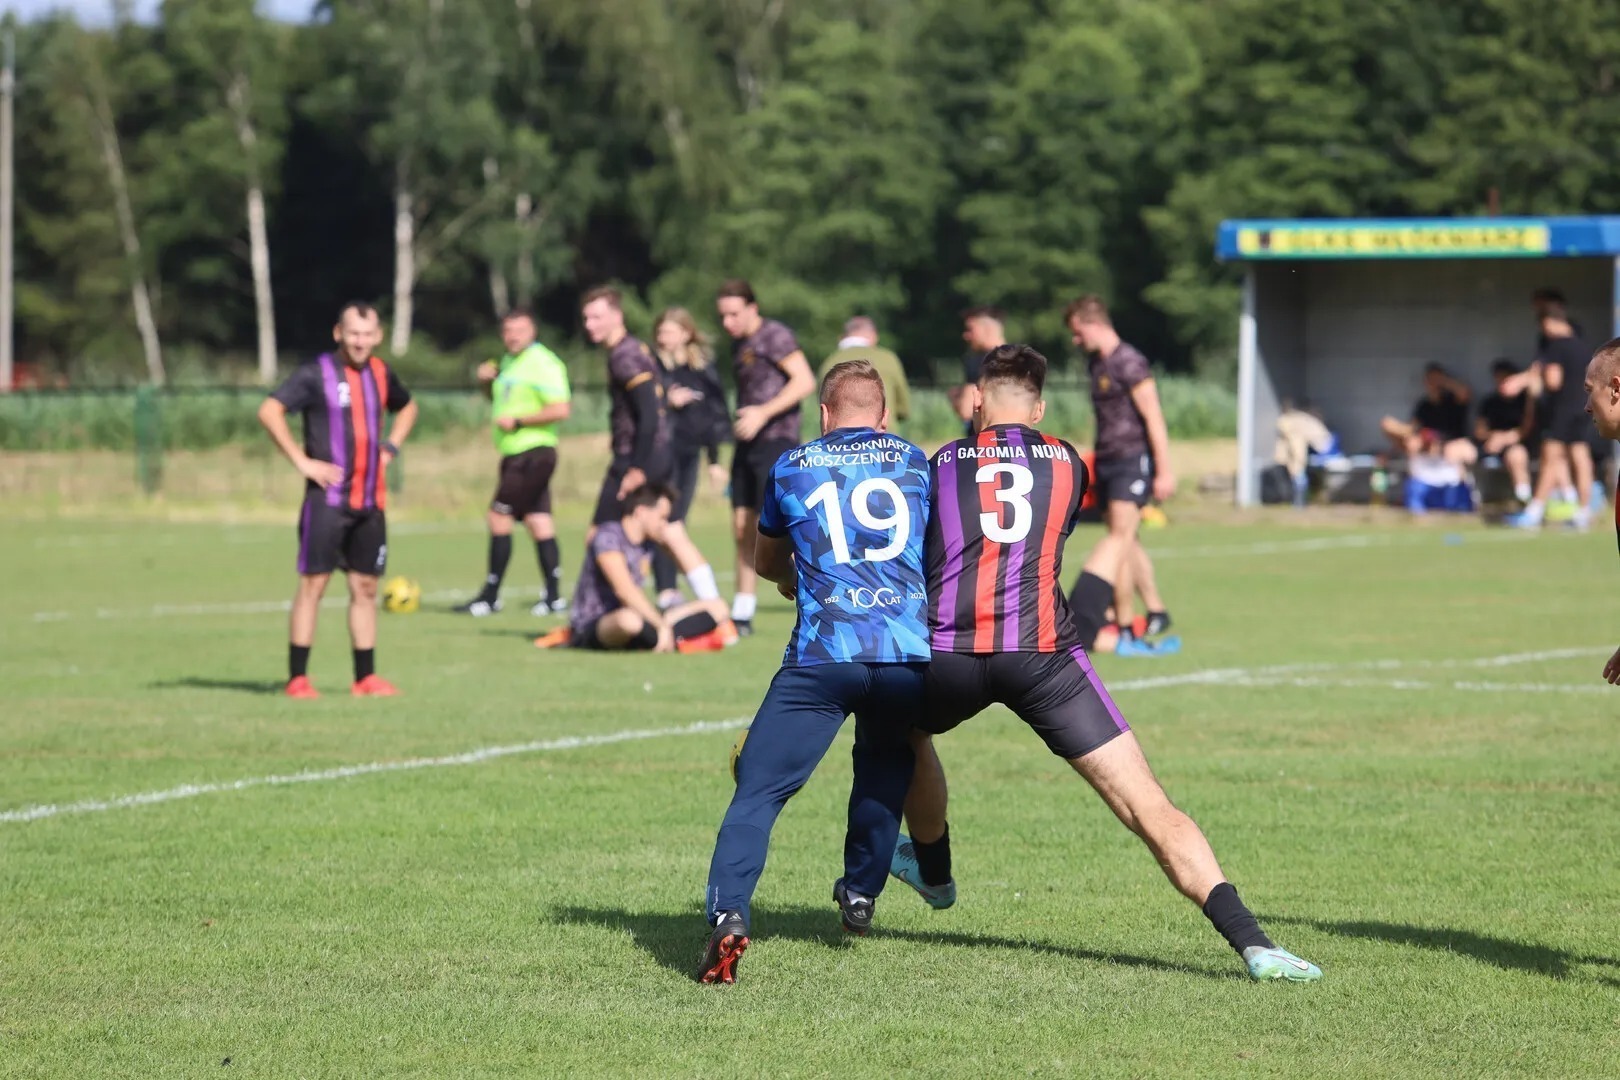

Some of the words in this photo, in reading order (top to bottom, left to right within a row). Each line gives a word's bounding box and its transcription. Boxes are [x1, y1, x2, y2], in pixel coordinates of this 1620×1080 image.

[789, 444, 822, 460] GLKS
[800, 451, 904, 470] MOSZCZENICA
[937, 450, 952, 467] FC
[957, 447, 1026, 459] GAZOMIA
[1032, 444, 1072, 464] NOVA
[975, 462, 1034, 544] 3
[804, 477, 910, 564] 19
[824, 595, 840, 604] 1922
[884, 596, 901, 604] LAT
